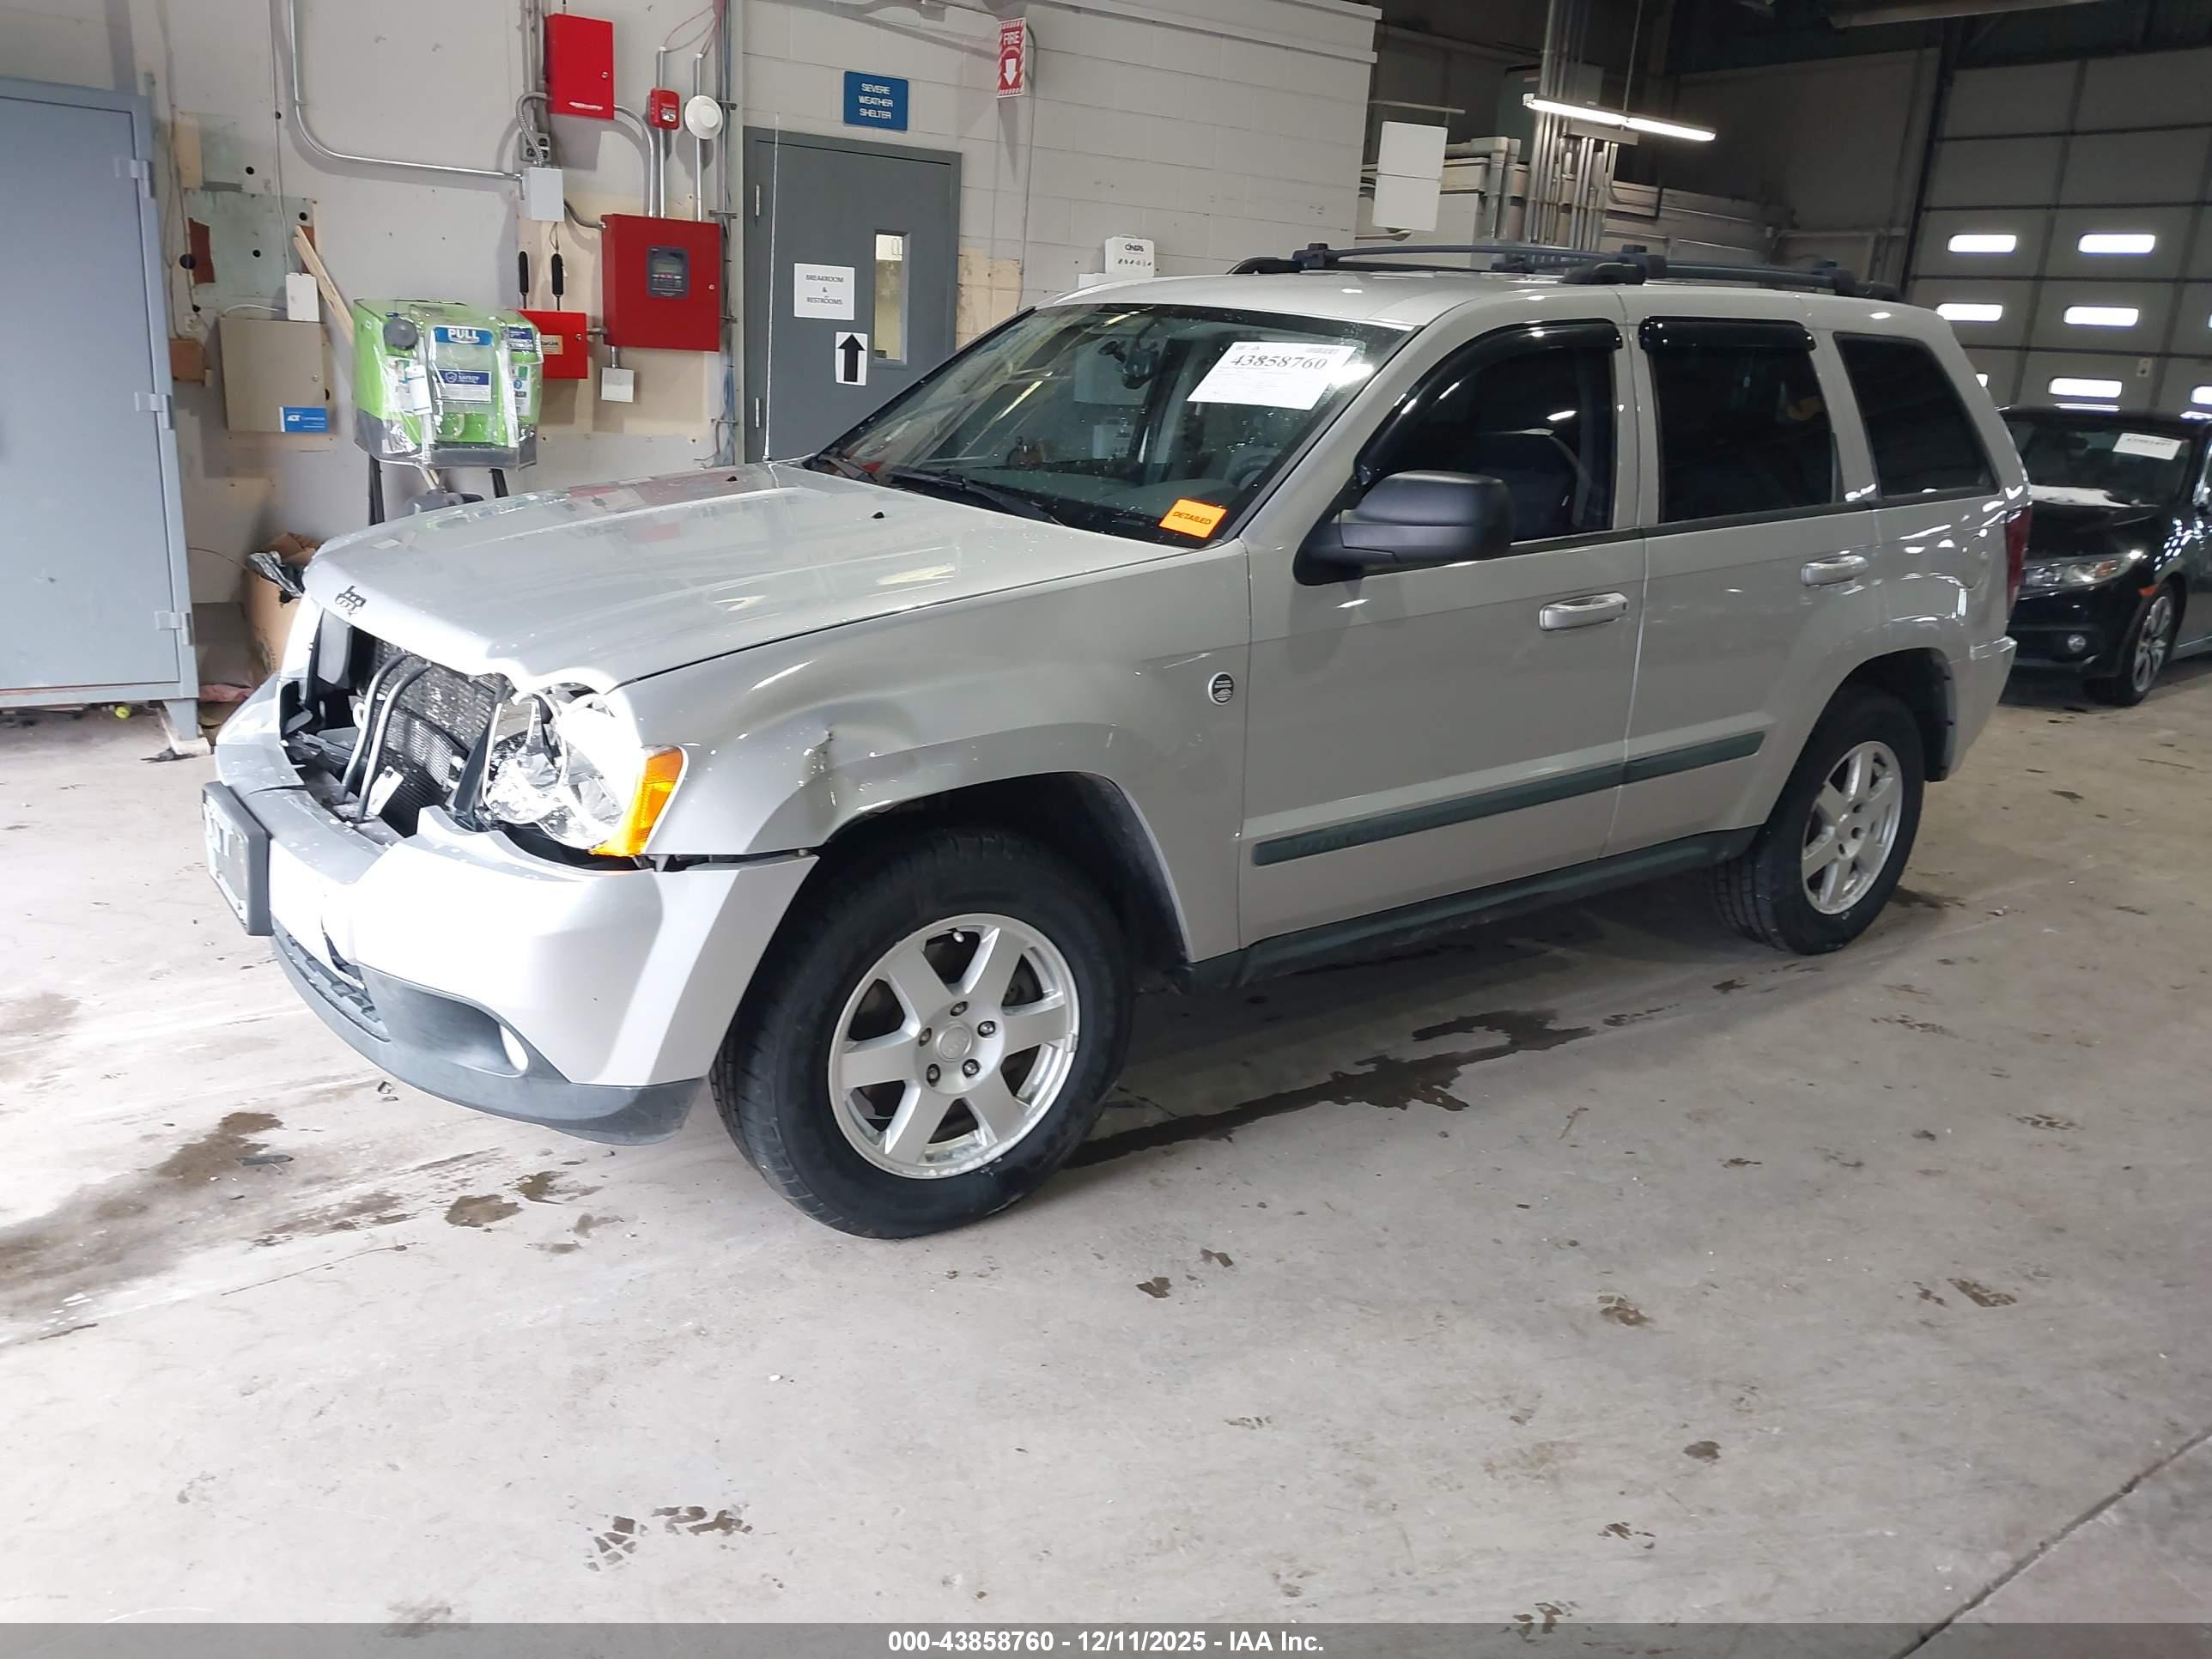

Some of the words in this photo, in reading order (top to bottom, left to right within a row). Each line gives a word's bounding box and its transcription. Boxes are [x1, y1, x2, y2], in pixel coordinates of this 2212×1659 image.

[1004, 31, 1020, 46] FIRE
[861, 82, 891, 94] SEVERE
[858, 95, 893, 107] WEATHER
[860, 108, 891, 119] SHELTER
[805, 274, 844, 283] BREAKROOM
[806, 296, 842, 305] RESTROOMS
[447, 328, 480, 339] PULL
[1231, 355, 1328, 370] 43858760
[1173, 511, 1212, 525] DETAILED
